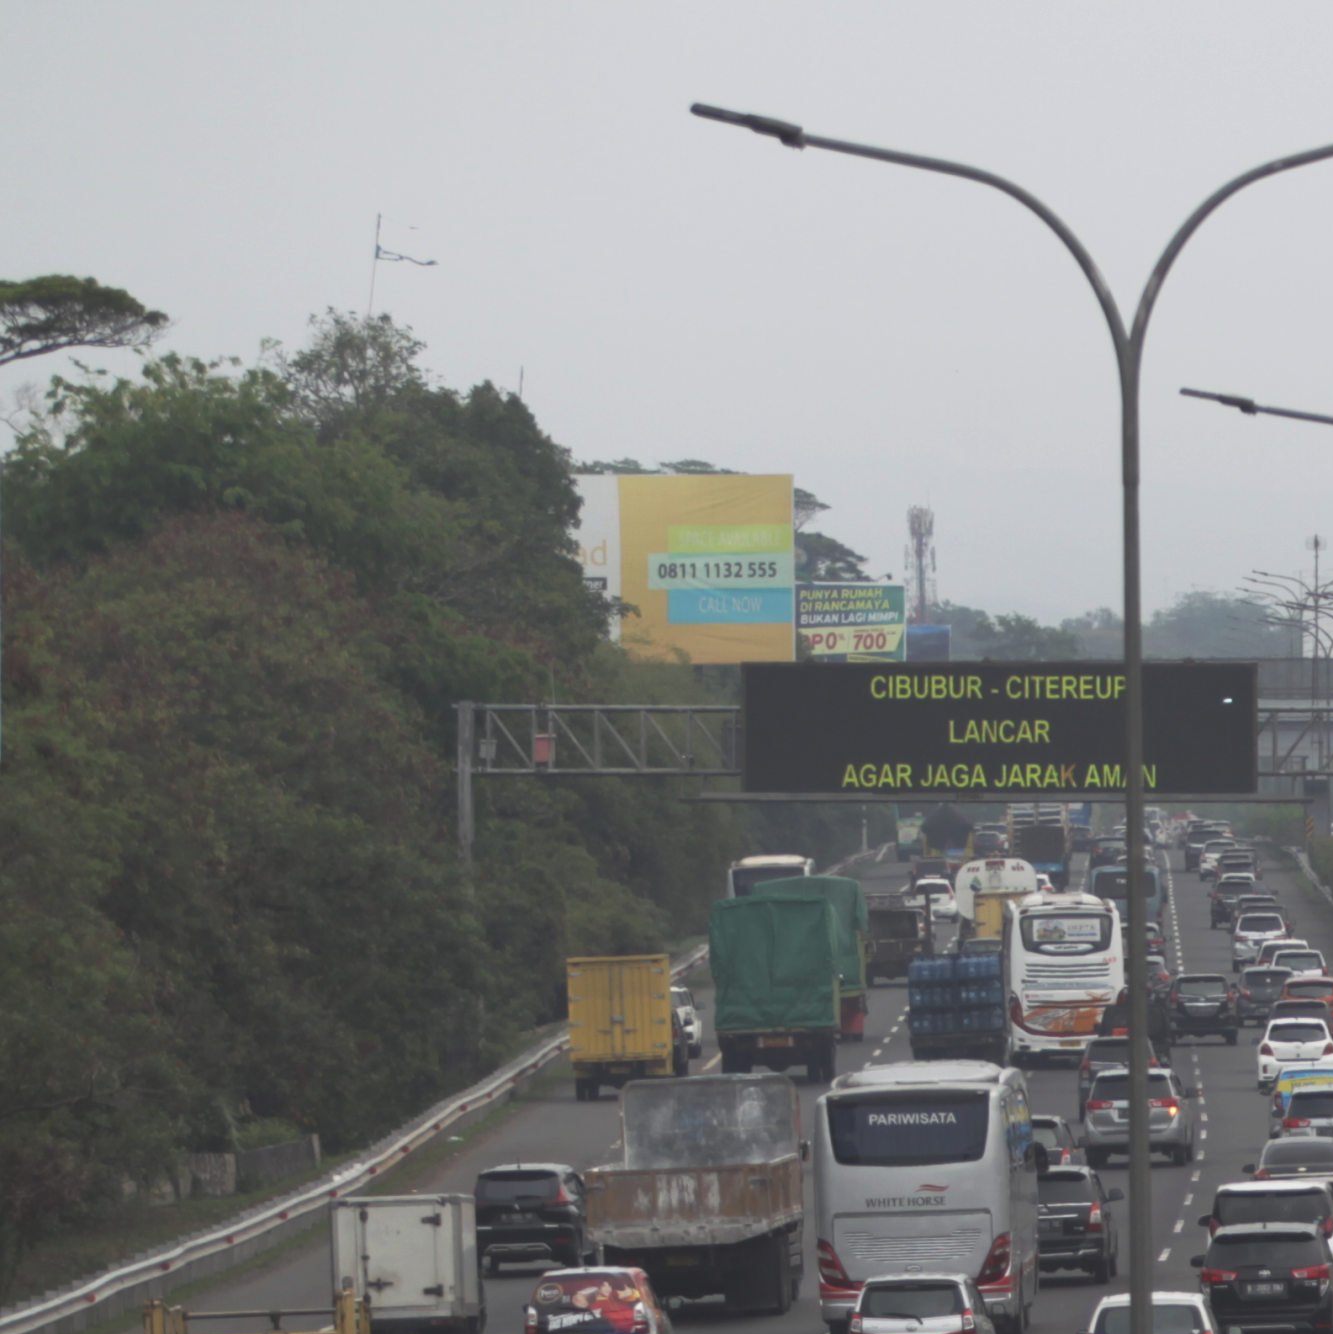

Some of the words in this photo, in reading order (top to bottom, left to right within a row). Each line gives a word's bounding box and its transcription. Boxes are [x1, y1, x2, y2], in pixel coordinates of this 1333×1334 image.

[658, 563, 697, 579] 0811
[704, 563, 743, 578] 1132
[747, 562, 777, 578] 555
[800, 590, 839, 600] PUNYA
[841, 588, 883, 599] RUMAH
[699, 597, 728, 613] CALL
[732, 597, 763, 612] NOW
[801, 602, 813, 612] DI
[815, 600, 890, 611] RANCAMAYA
[801, 613, 839, 624] BUKAN
[842, 612, 867, 623] LAGI
[853, 632, 887, 651] 700
[870, 675, 983, 699] CIBUBUR
[949, 720, 1050, 743] LANCAR
[842, 764, 912, 788] AGAR
[921, 764, 987, 788] JAGA
[994, 764, 1077, 788] JARAK
[1084, 764, 1156, 788] AMN
[868, 1111, 957, 1126] PARIWISATA
[865, 1198, 904, 1208] WHITE
[907, 1195, 946, 1207] HORSE
